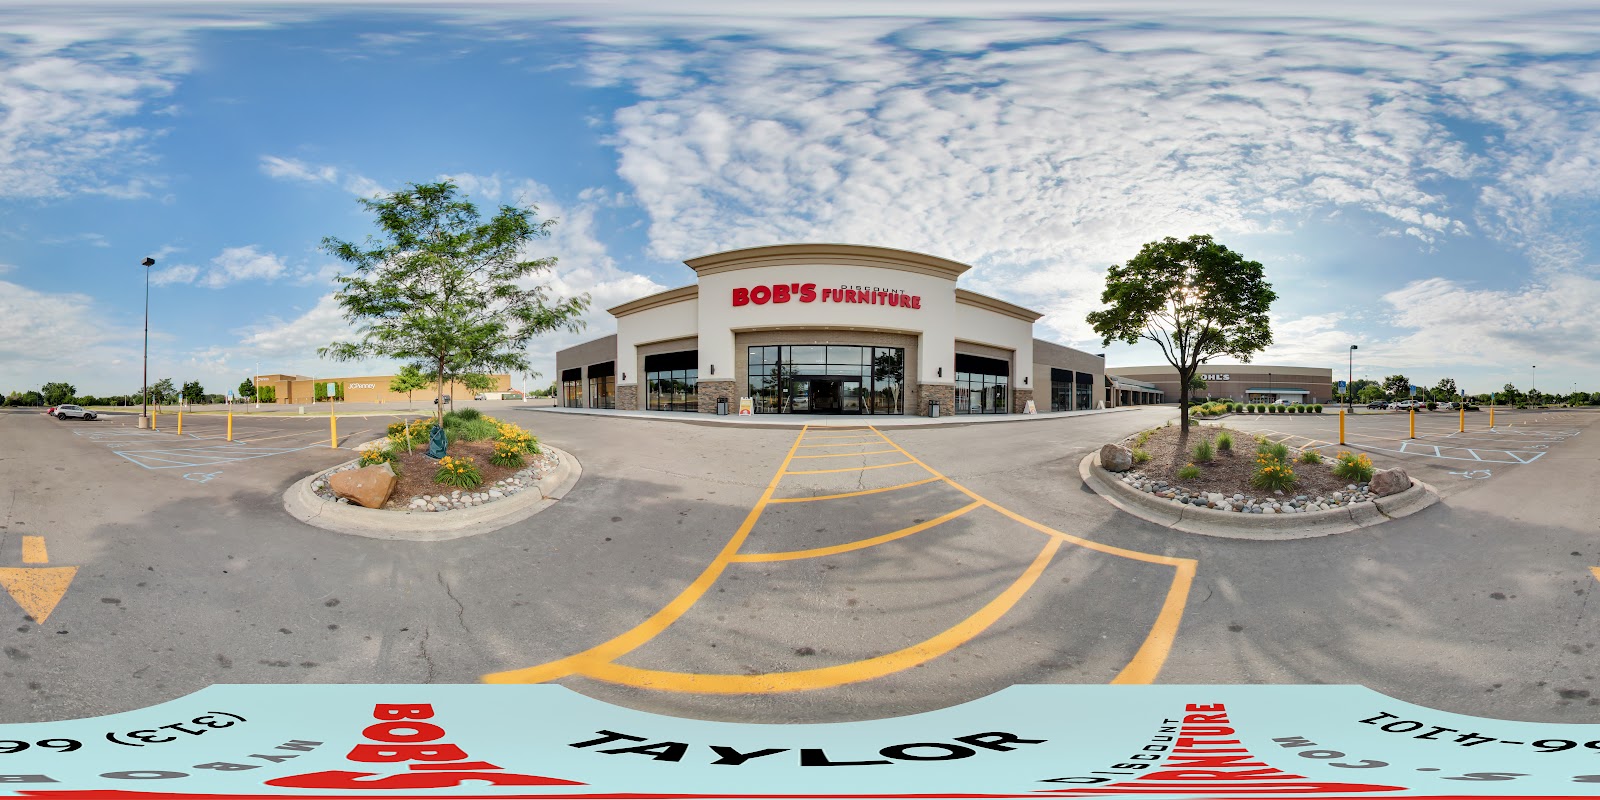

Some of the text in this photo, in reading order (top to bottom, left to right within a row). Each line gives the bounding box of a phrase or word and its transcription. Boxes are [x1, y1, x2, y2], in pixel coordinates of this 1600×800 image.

[733, 284, 922, 309] BOB'S FURNITURE
[840, 284, 906, 295] DISCOUNT
